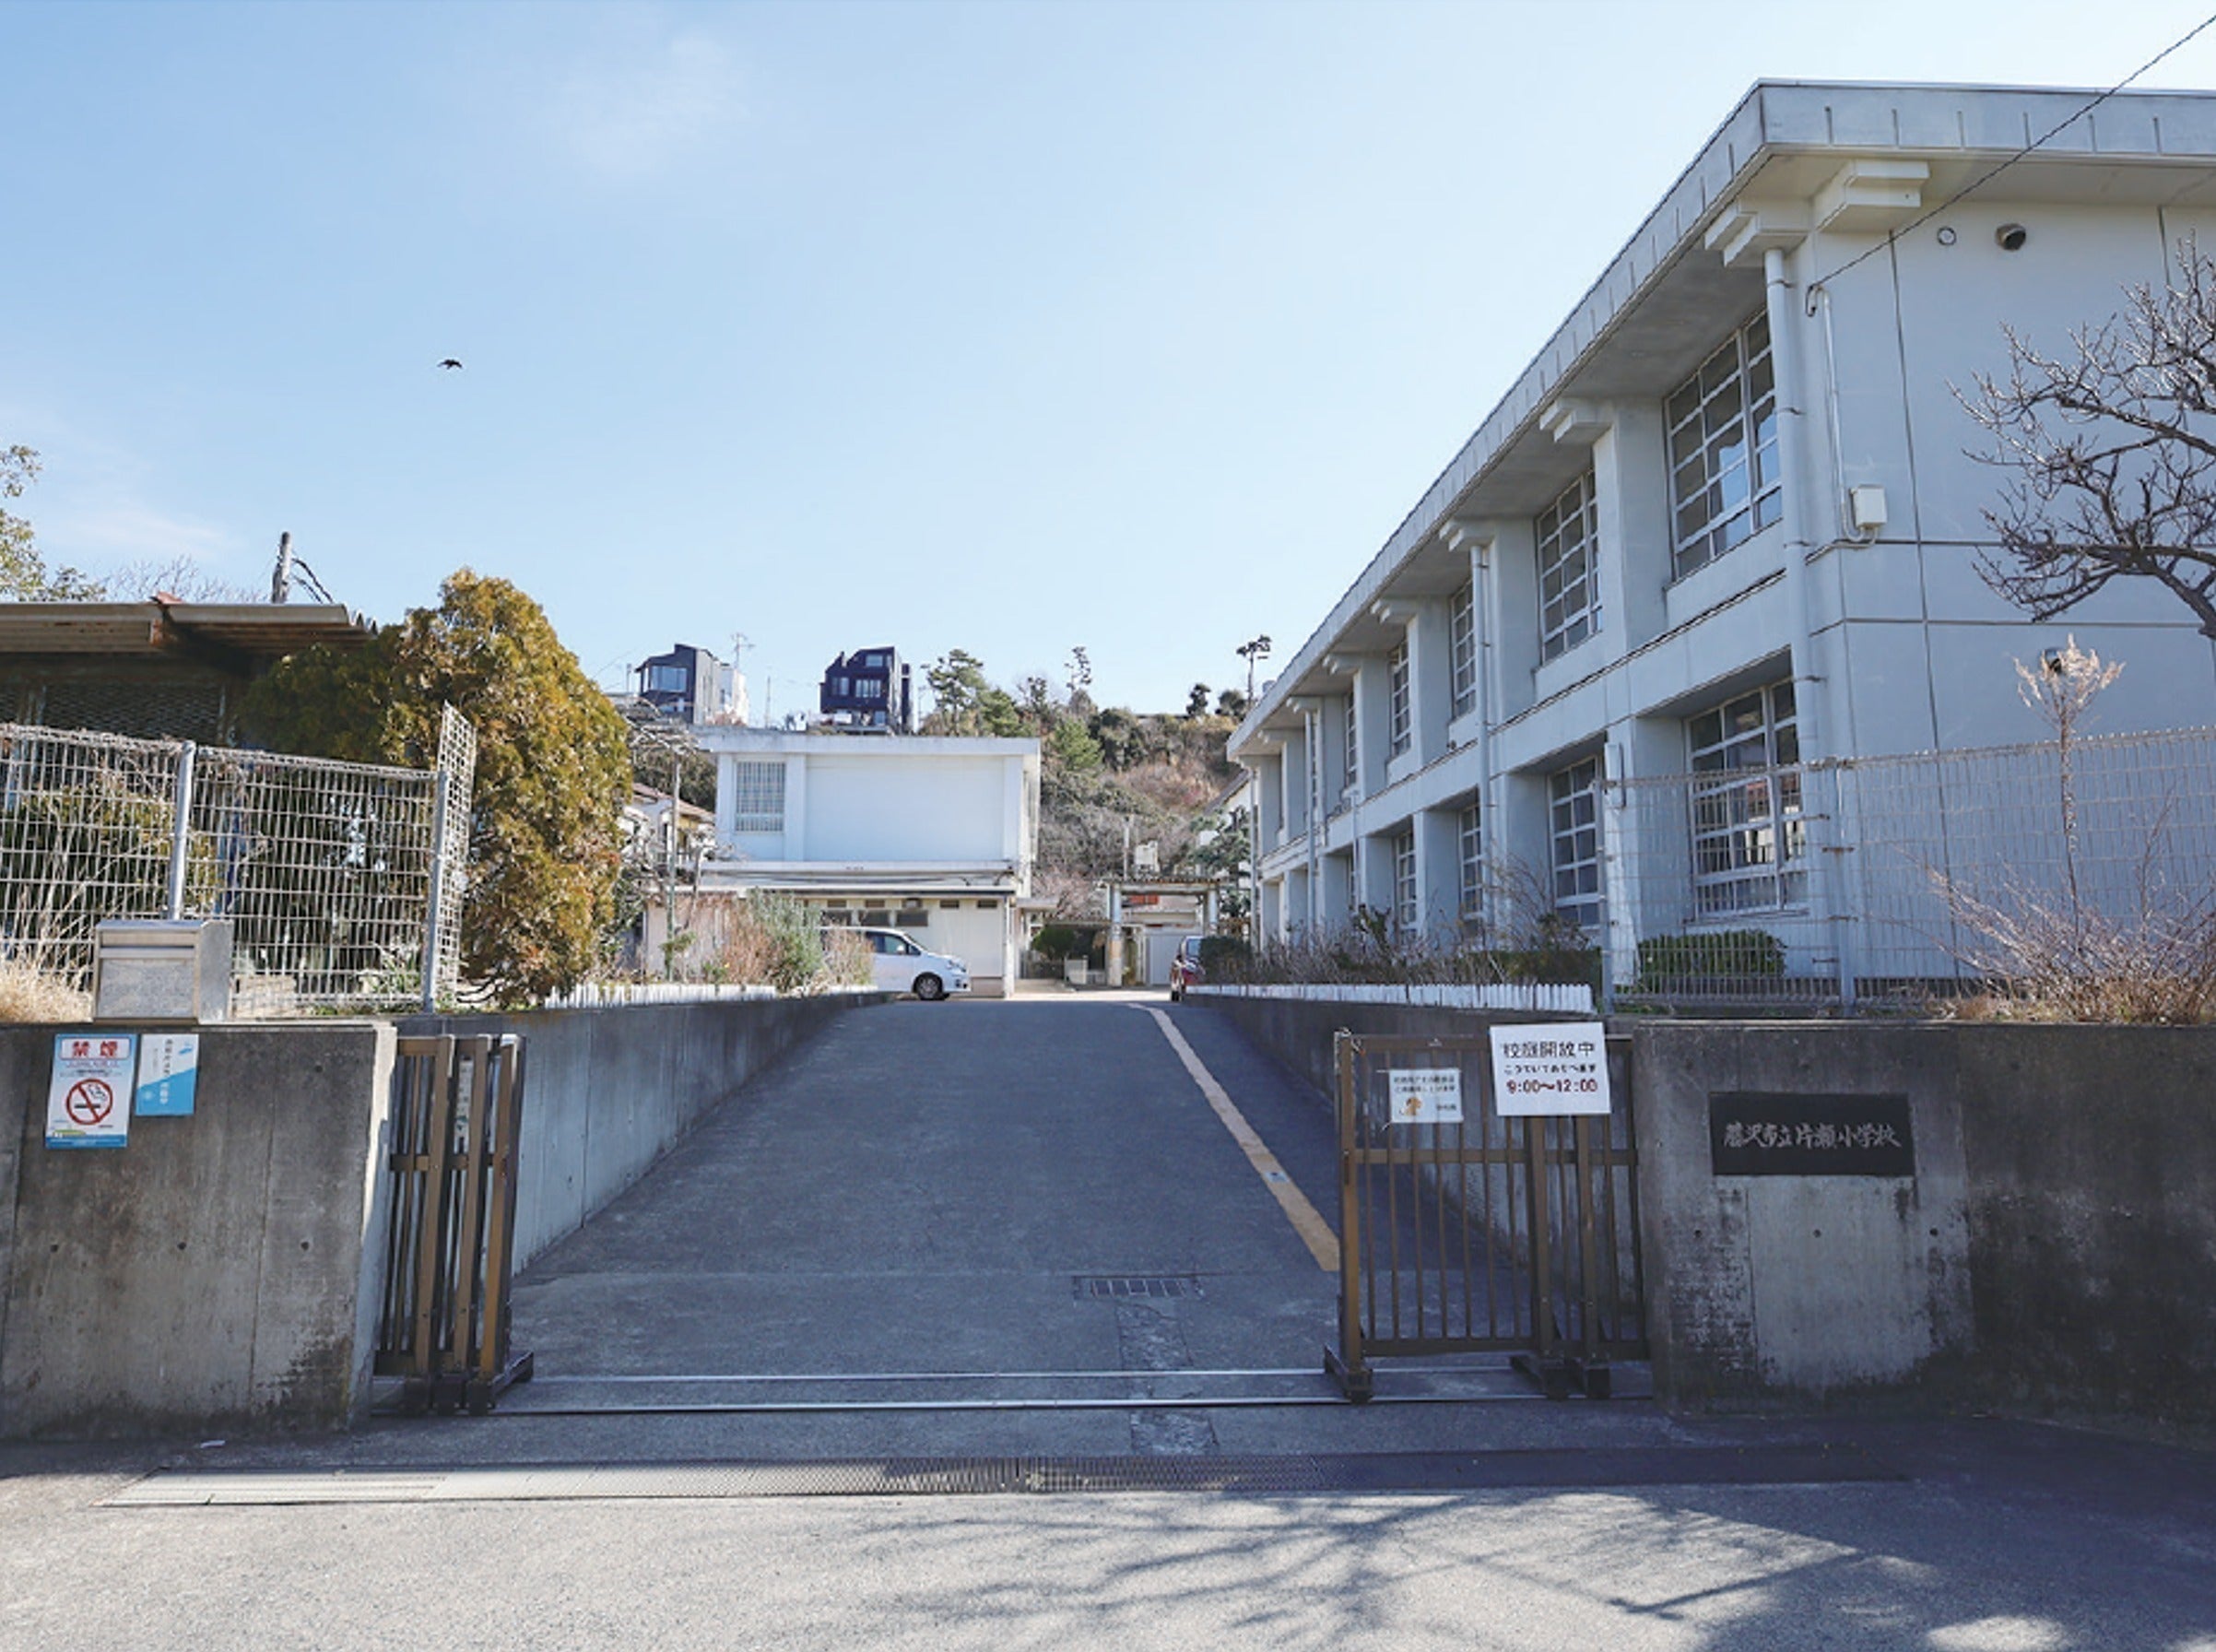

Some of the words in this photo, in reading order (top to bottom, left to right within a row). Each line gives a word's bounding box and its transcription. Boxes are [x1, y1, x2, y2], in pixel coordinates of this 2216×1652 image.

[1503, 1041, 1595, 1058] 校庭開放中
